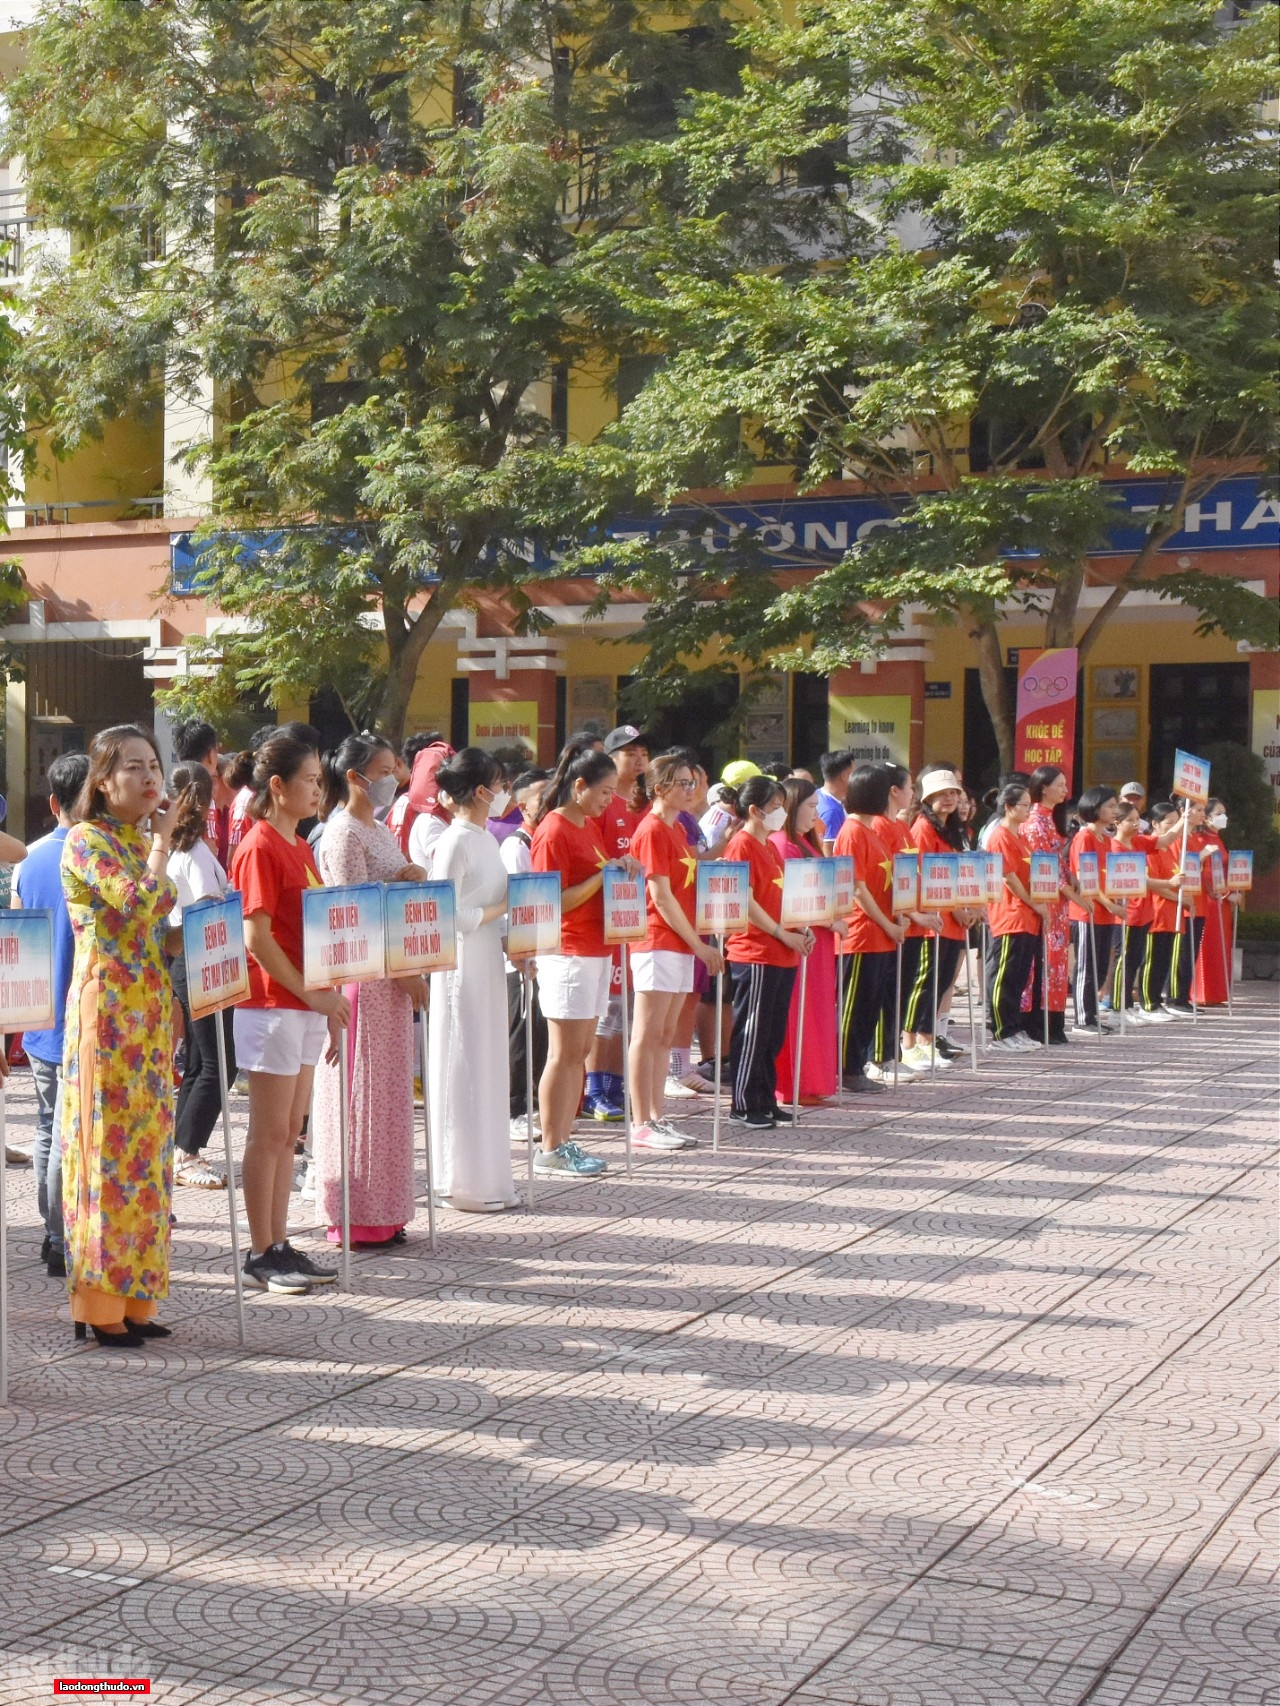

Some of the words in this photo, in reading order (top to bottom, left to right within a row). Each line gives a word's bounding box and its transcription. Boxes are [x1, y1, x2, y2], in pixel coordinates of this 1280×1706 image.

[844, 720, 870, 735] Learning
[871, 720, 877, 733] to
[878, 720, 895, 733] know
[1025, 720, 1049, 739] KHỎE
[1051, 719, 1065, 739] ĐỂ
[882, 745, 890, 759] do
[1024, 749, 1042, 767] HỌC
[617, 837, 631, 849] SO
[329, 904, 344, 935] BỆNH
[346, 901, 359, 932] VIỆN
[404, 899, 421, 928] BỆNH
[423, 897, 438, 927] VIỆN
[4, 931, 19, 971] VIỆN
[333, 937, 348, 966] BƯỚU
[403, 927, 420, 957] PHỔI
[420, 930, 429, 956] HÀ
[430, 929, 441, 958] NỘI
